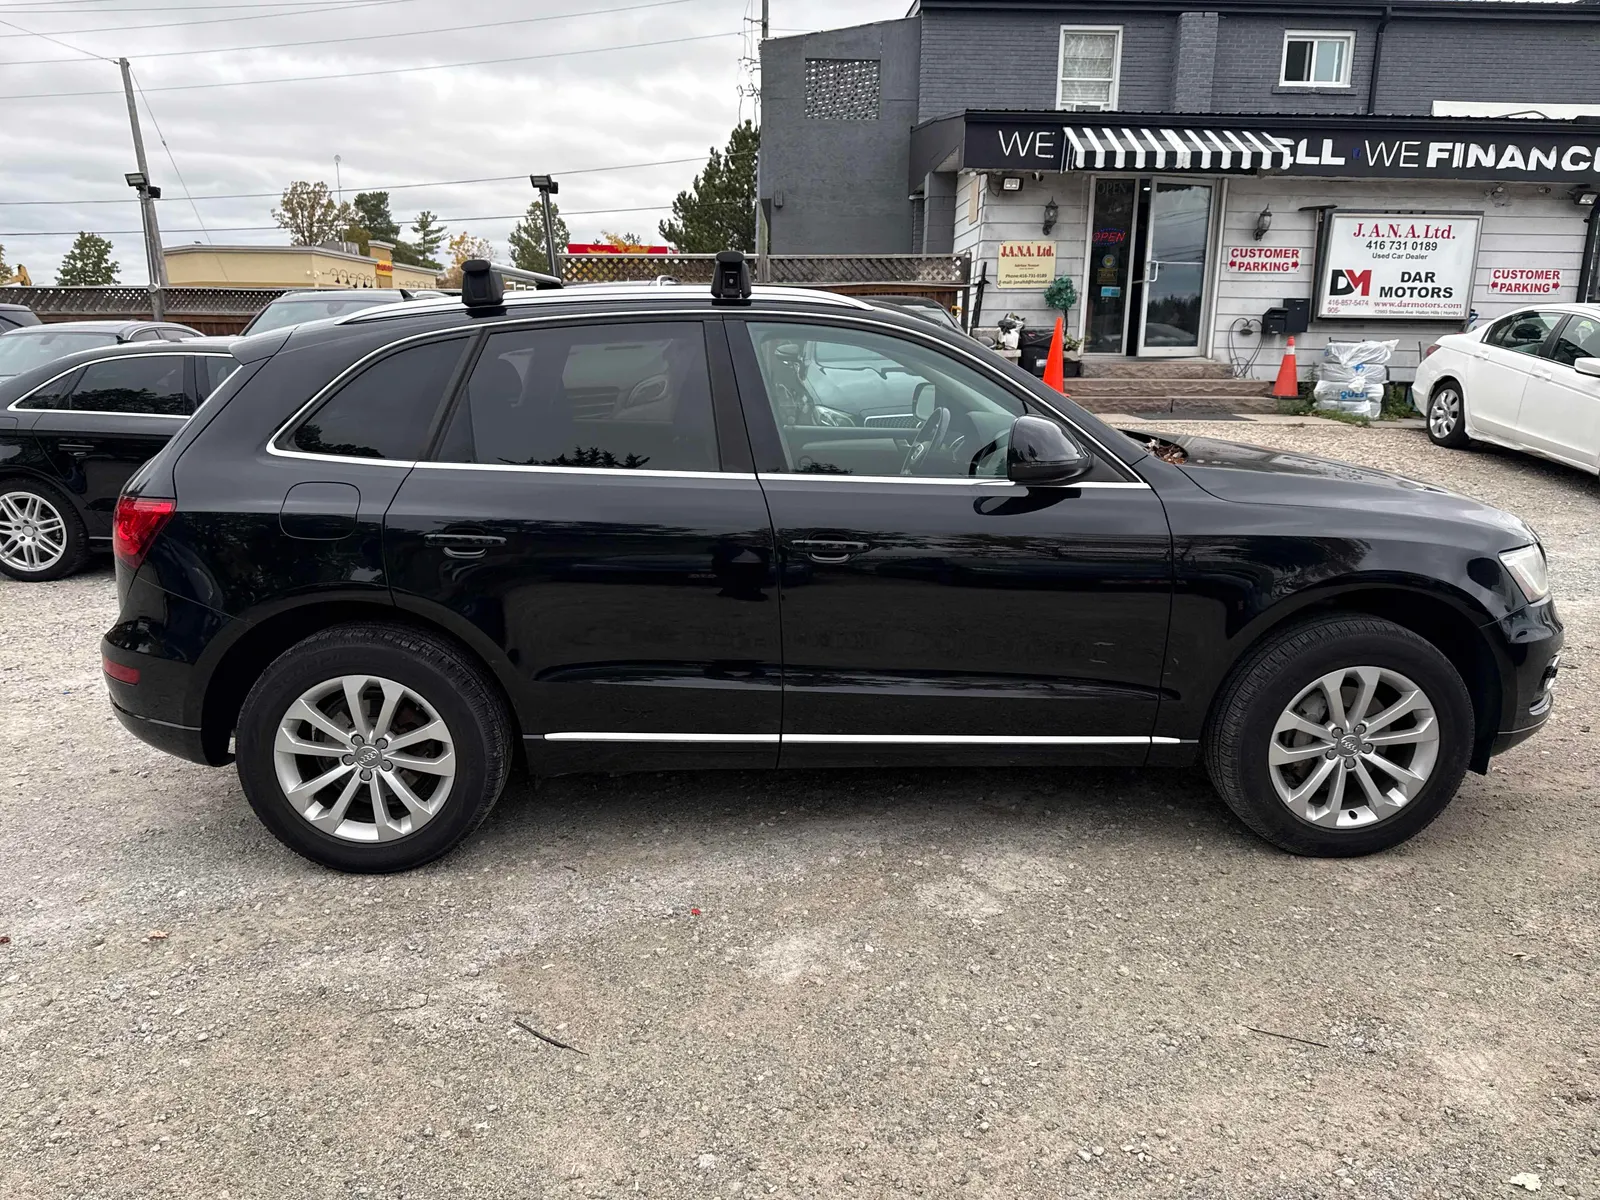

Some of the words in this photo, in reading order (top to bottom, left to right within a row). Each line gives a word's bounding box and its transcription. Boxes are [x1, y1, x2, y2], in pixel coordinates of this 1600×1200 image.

[998, 130, 1055, 158] WE
[1364, 140, 1421, 167] WE
[1092, 232, 1126, 242] OPEN
[1423, 224, 1456, 239] Ltd.
[1001, 245, 1034, 257] J.A.N.A.
[1036, 245, 1054, 257] Ltd.
[1366, 241, 1386, 250] 416
[1389, 241, 1408, 250] 731
[1411, 241, 1438, 251] 0189
[1231, 248, 1300, 259] CUSTOMER
[1238, 261, 1290, 272] PARKING
[1400, 271, 1436, 283] DAR
[1493, 269, 1560, 280] CUSTOMER
[1329, 269, 1372, 296] DM
[1499, 282, 1550, 293] PARKING
[1379, 286, 1453, 299] MOTORS
[1374, 301, 1462, 309] www.darmotors.com
